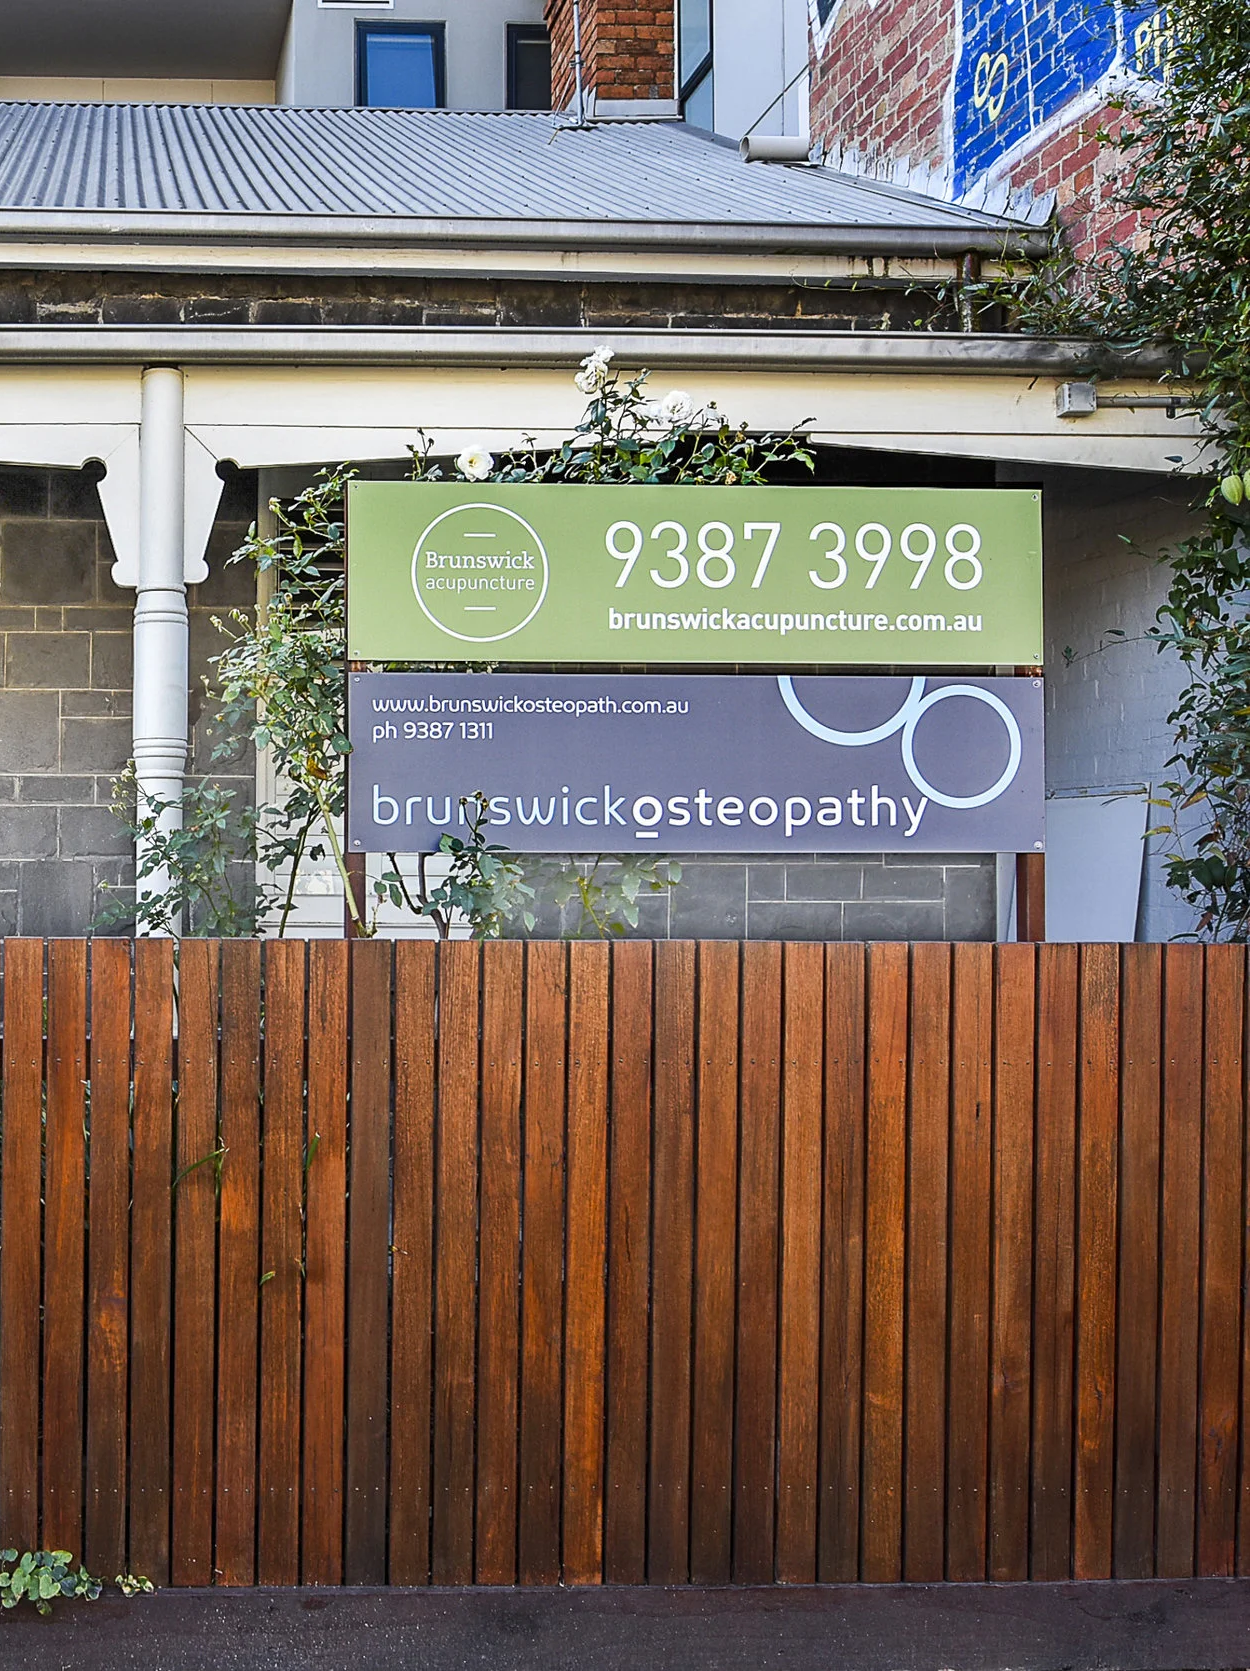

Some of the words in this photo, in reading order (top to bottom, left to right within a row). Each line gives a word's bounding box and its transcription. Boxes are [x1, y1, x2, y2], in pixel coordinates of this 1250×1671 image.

[425, 550, 536, 569] Brunswick
[604, 520, 782, 589] 9387
[808, 521, 983, 590] 3998
[425, 575, 536, 595] acupuncture
[607, 607, 983, 635] brunswickacupuncture.com.au
[372, 695, 690, 717] www.brunswickosteopath.com.au
[372, 721, 397, 743] ph
[403, 721, 455, 740] 9387
[459, 721, 494, 740] 1311
[371, 783, 929, 839] brunswickosteopathy
